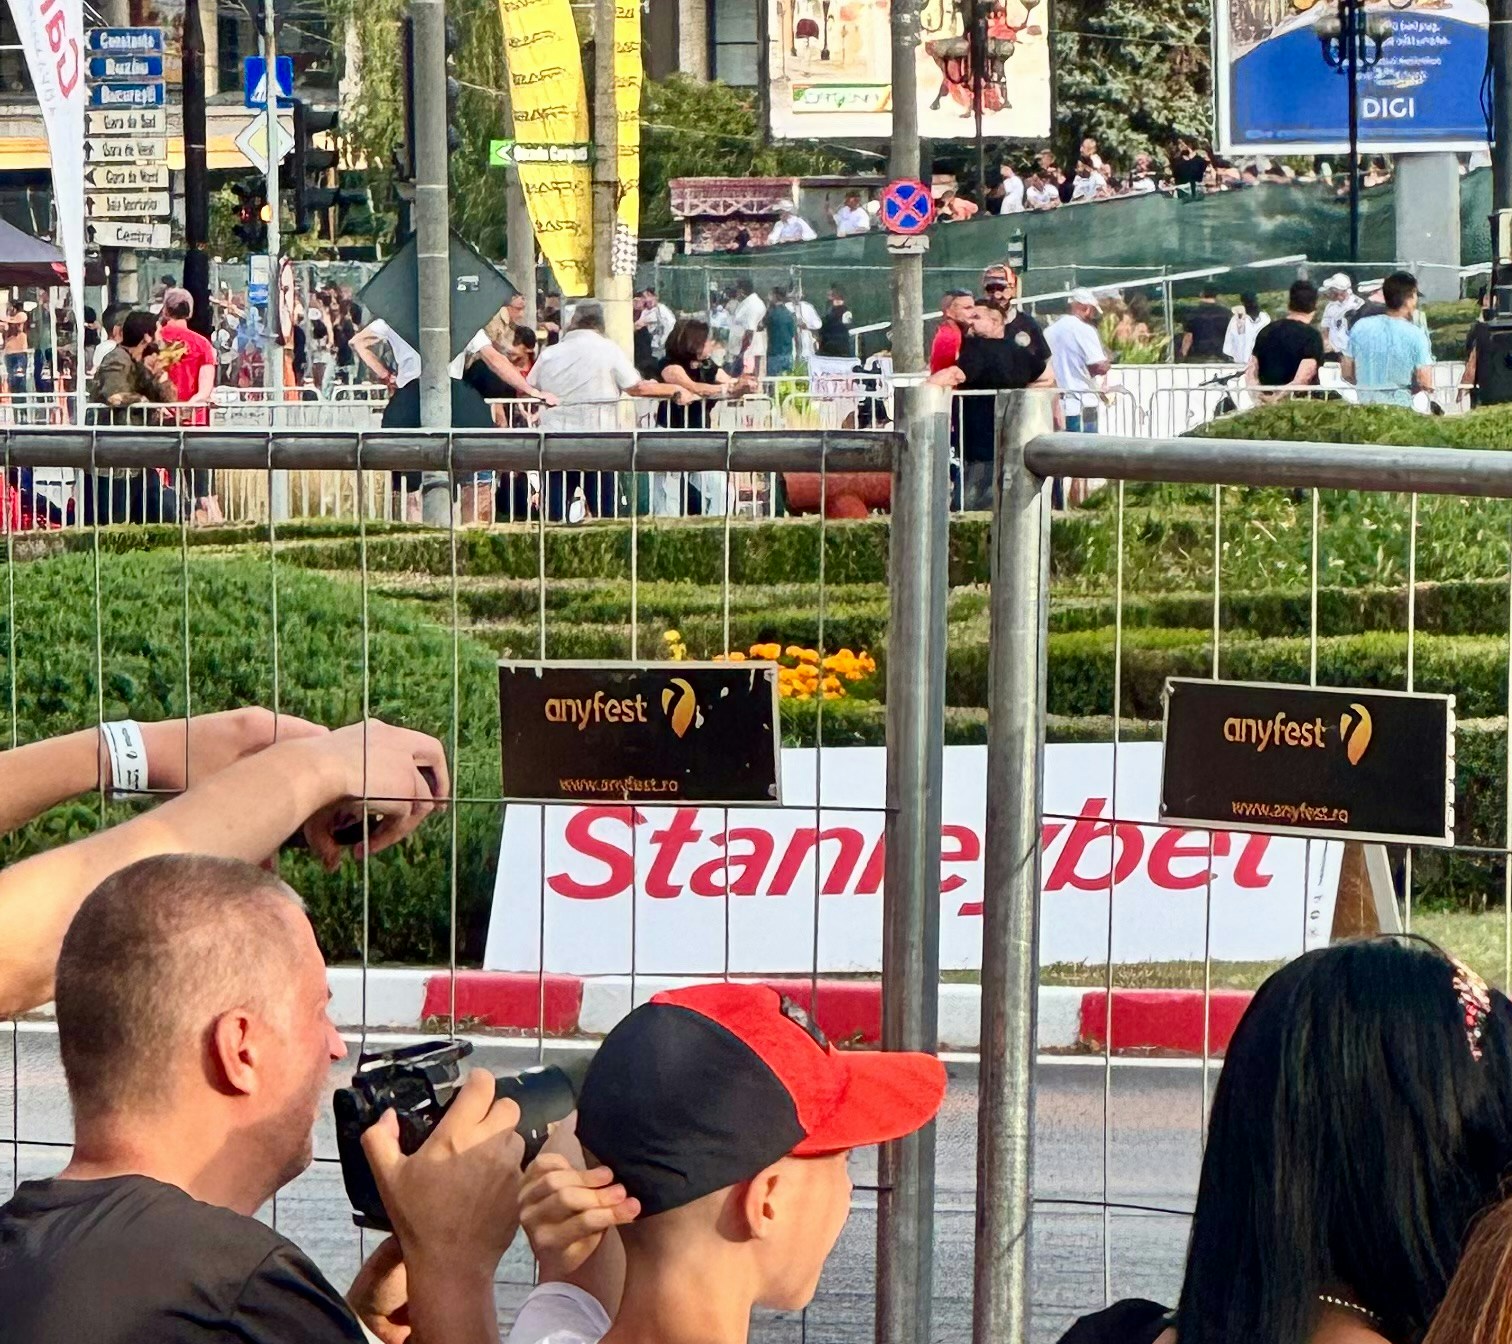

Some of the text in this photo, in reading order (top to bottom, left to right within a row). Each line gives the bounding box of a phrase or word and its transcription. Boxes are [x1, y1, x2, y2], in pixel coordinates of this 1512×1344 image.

[1361, 97, 1415, 119] DIGI
[545, 691, 648, 731] anyfest
[1223, 711, 1326, 752] anyfest
